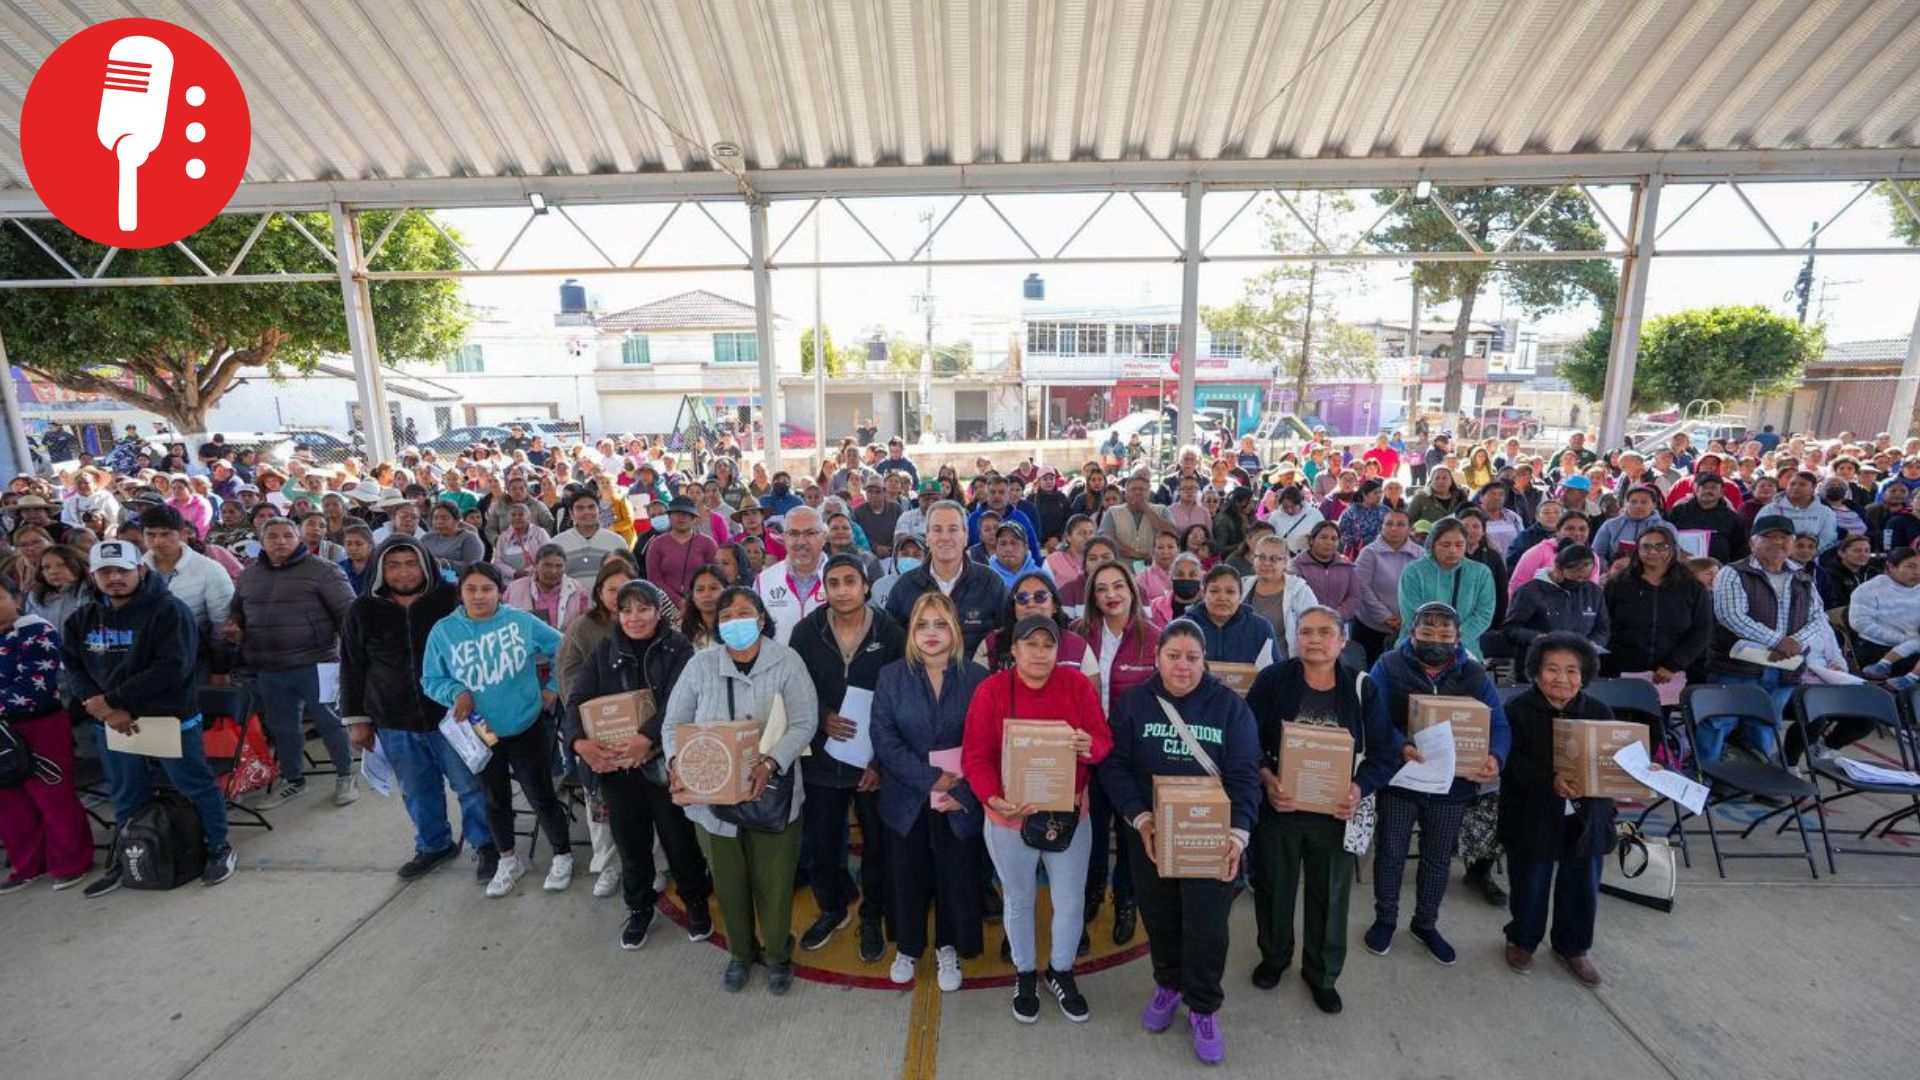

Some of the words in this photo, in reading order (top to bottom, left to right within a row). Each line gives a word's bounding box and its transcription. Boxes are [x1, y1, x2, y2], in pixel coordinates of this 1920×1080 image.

[455, 645, 527, 692] SQUAD
[1143, 723, 1178, 737] POLO
[1180, 724, 1223, 743] NION
[1163, 739, 1194, 755] CLU
